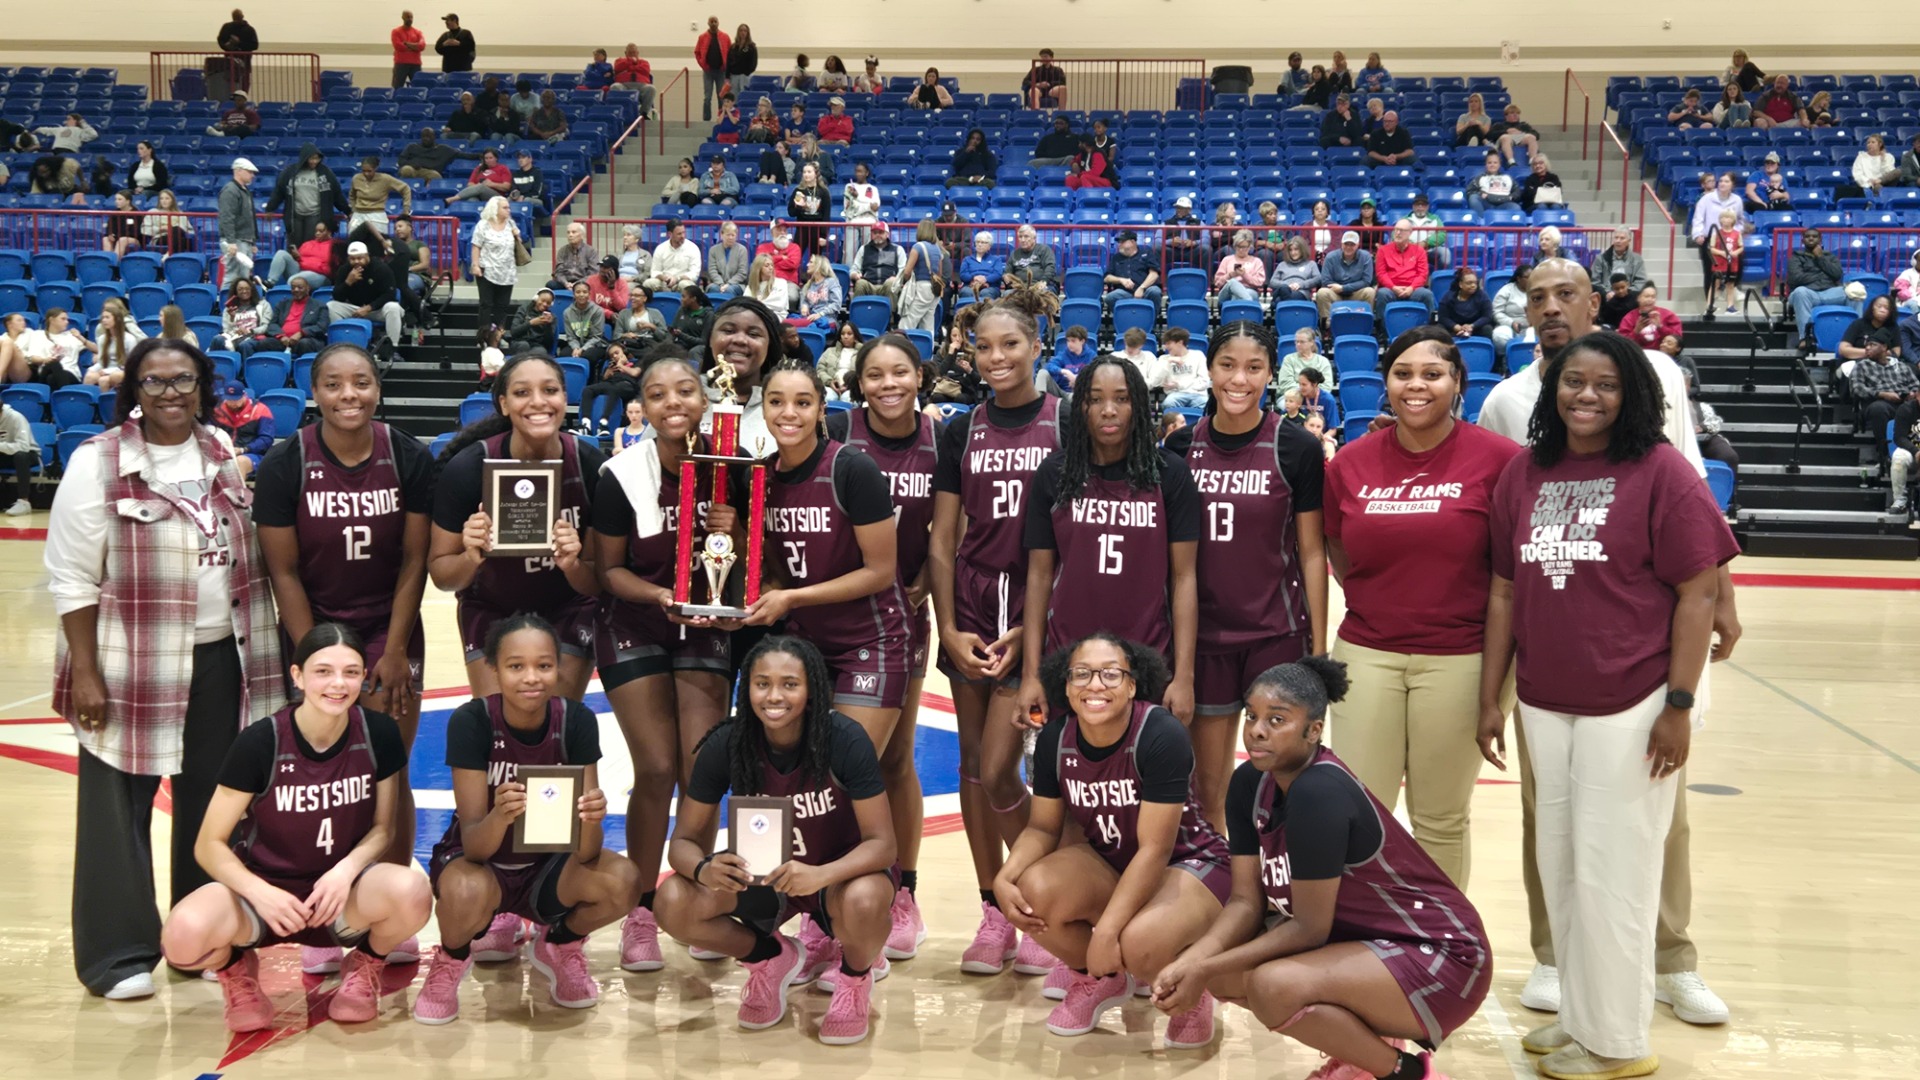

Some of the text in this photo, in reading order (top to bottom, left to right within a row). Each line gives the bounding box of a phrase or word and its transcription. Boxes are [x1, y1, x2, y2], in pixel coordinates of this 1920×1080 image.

[993, 479, 1023, 519] 20
[1357, 483, 1463, 499] LADY RAMS
[1538, 477, 1616, 497] NOTHING
[306, 488, 400, 517] WESTSIDE
[1072, 498, 1157, 528] WESTSIDE
[1368, 502, 1436, 512] BASKETBALL
[1534, 493, 1616, 512] CAN STOP
[1207, 502, 1235, 541] 13
[1530, 508, 1609, 527] WHAT WE
[342, 526, 372, 560] 12
[1531, 524, 1597, 543] CAN DO
[1097, 533, 1124, 575] 15
[1520, 540, 1609, 563] TOGETHER.
[1541, 560, 1573, 569] LADY RAMS
[275, 774, 372, 812] WESTSIDE
[1065, 778, 1140, 808] WESTSIDE
[316, 817, 335, 855] 4
[1096, 814, 1122, 850] 14
